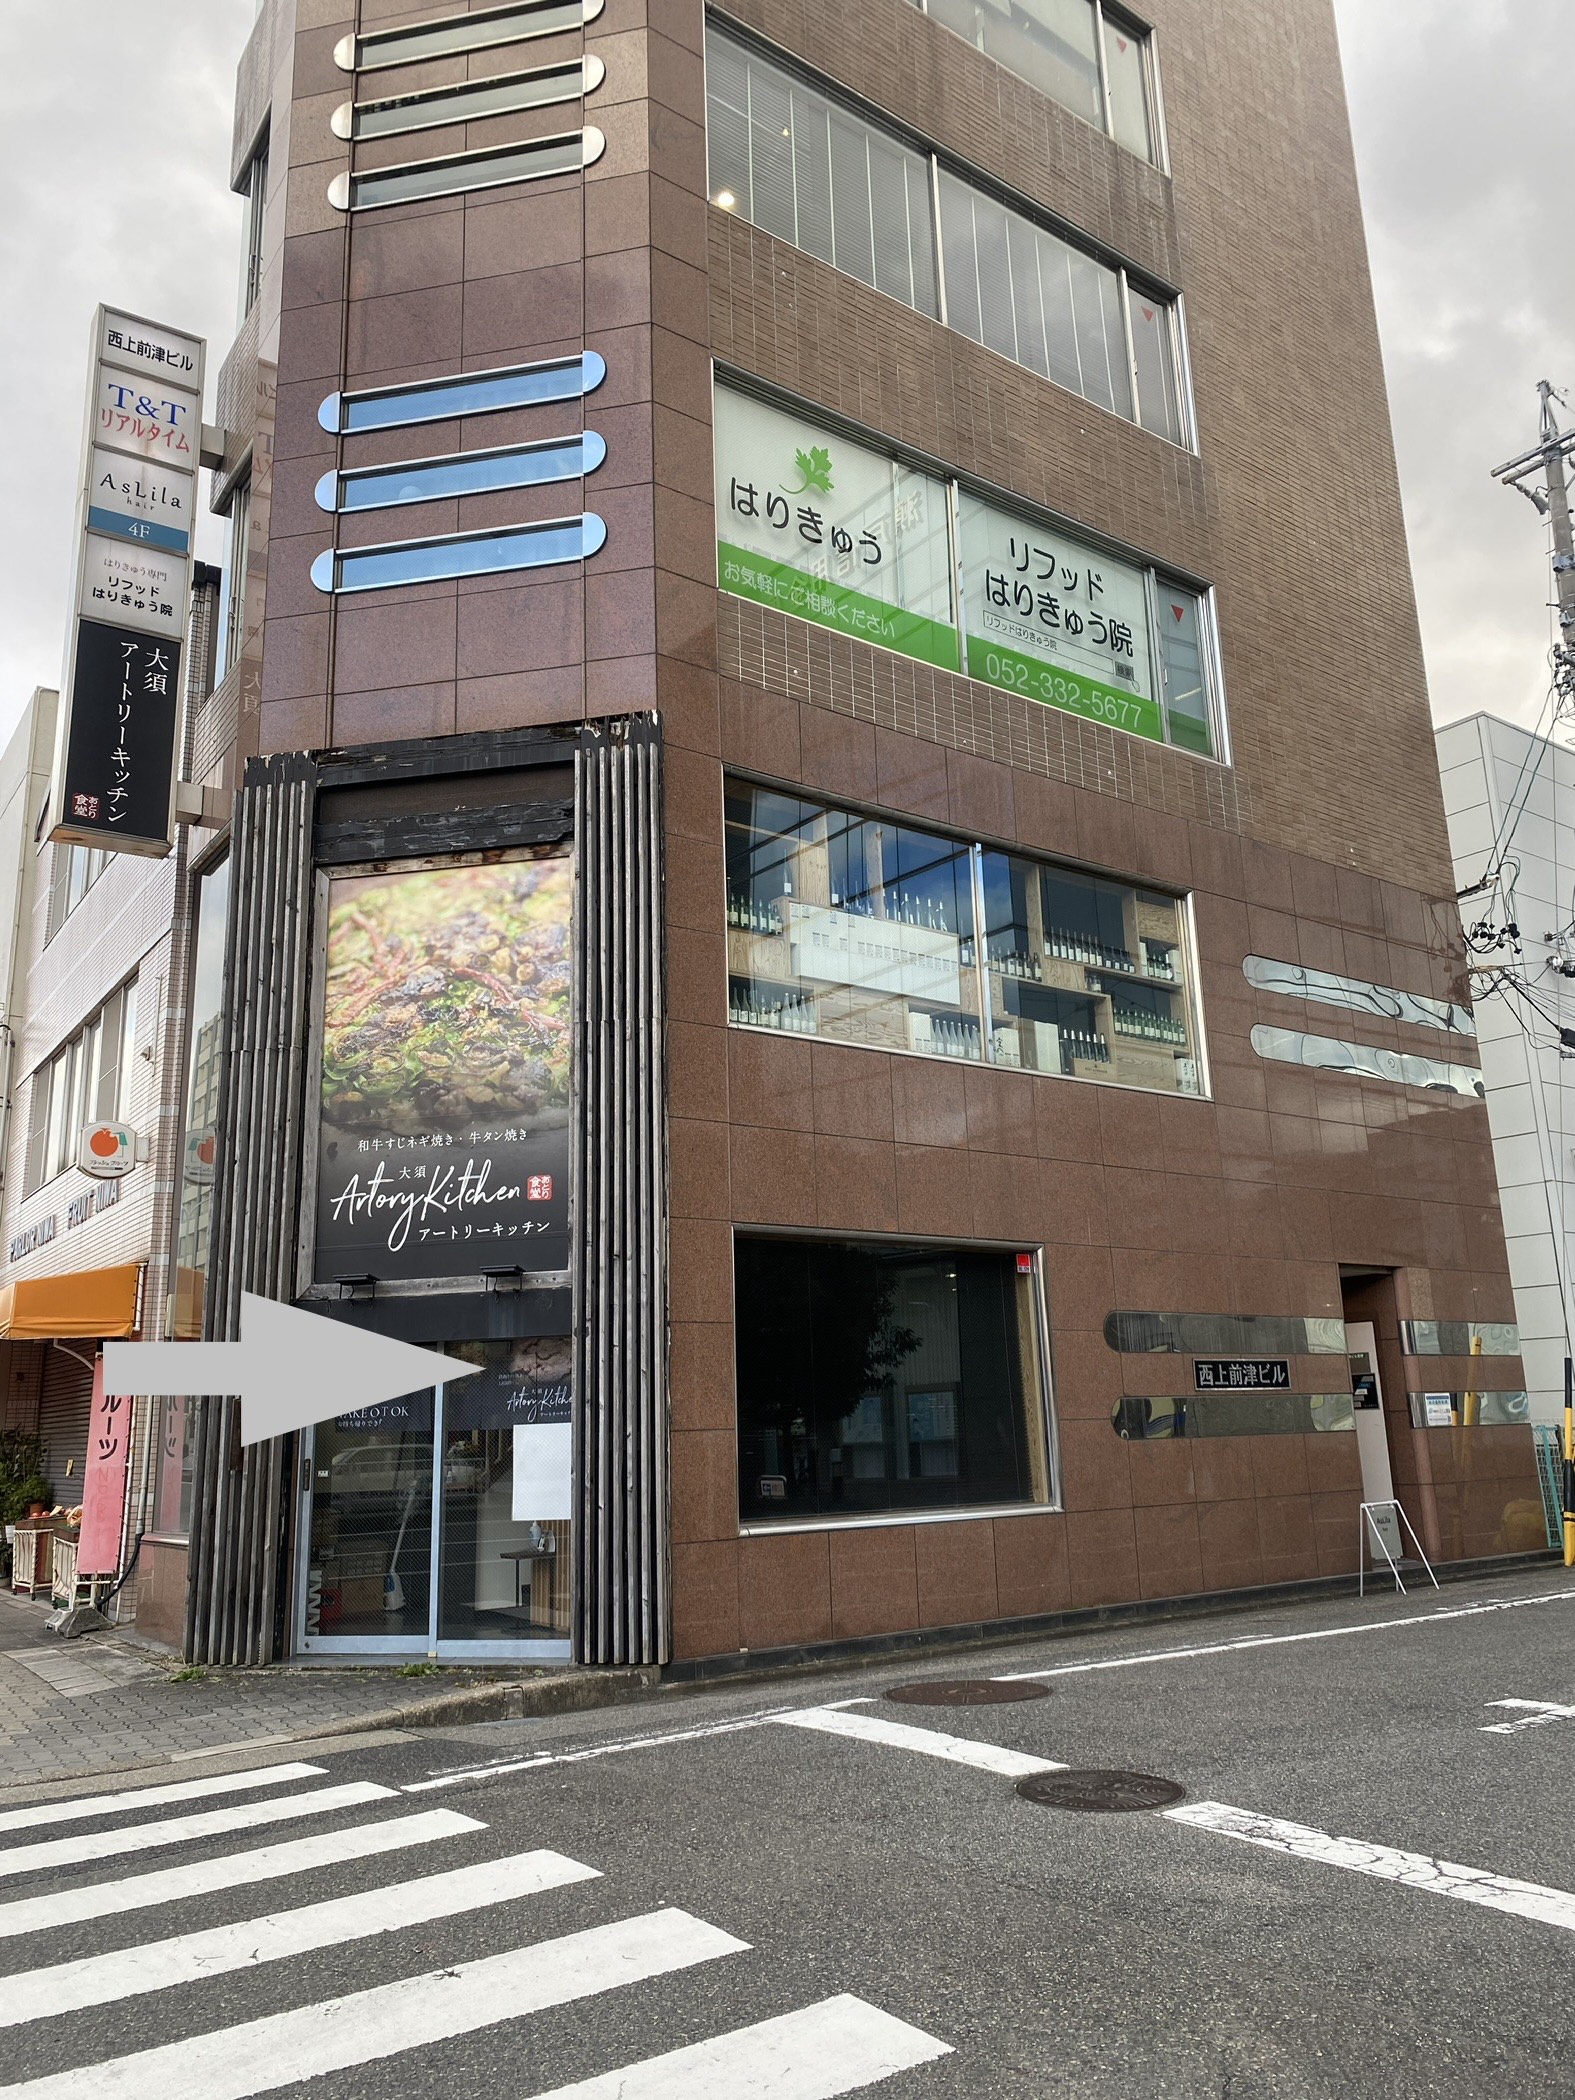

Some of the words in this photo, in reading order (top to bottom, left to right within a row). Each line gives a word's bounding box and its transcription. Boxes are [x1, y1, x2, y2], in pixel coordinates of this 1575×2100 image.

[107, 329, 193, 371] 西上前津ビル
[108, 383, 186, 426] T&T
[101, 408, 189, 453] リアルタイム
[100, 473, 182, 509] AsLila
[126, 496, 155, 511] hair
[128, 522, 150, 538] 4F
[731, 477, 882, 564] はりきゅう
[103, 558, 167, 582] はりきゅう専門
[108, 575, 160, 596] リフッド
[1010, 537, 1104, 601] リフッド
[92, 586, 173, 617] はりきゅう院
[724, 560, 895, 638] お気軽にご相談ください
[985, 569, 1134, 657] はりきゅう院
[986, 616, 1057, 651] リフッドはりきゅう院
[143, 648, 169, 696] 大須
[986, 653, 1142, 728] 052-332-5677
[107, 641, 139, 822] アートリーキッチン
[74, 794, 88, 817] 食堂
[358, 1128, 527, 1152] 和牛すじネギ焼き・牛タン焼き
[399, 1165, 427, 1180] 大須
[530, 1176, 542, 1199] 食堂
[418, 1221, 550, 1241] アートリーキッチン
[1198, 1363, 1286, 1386] 西上前津ビル
[98, 1395, 122, 1460] ルーツ
[391, 1406, 409, 1417] OK
